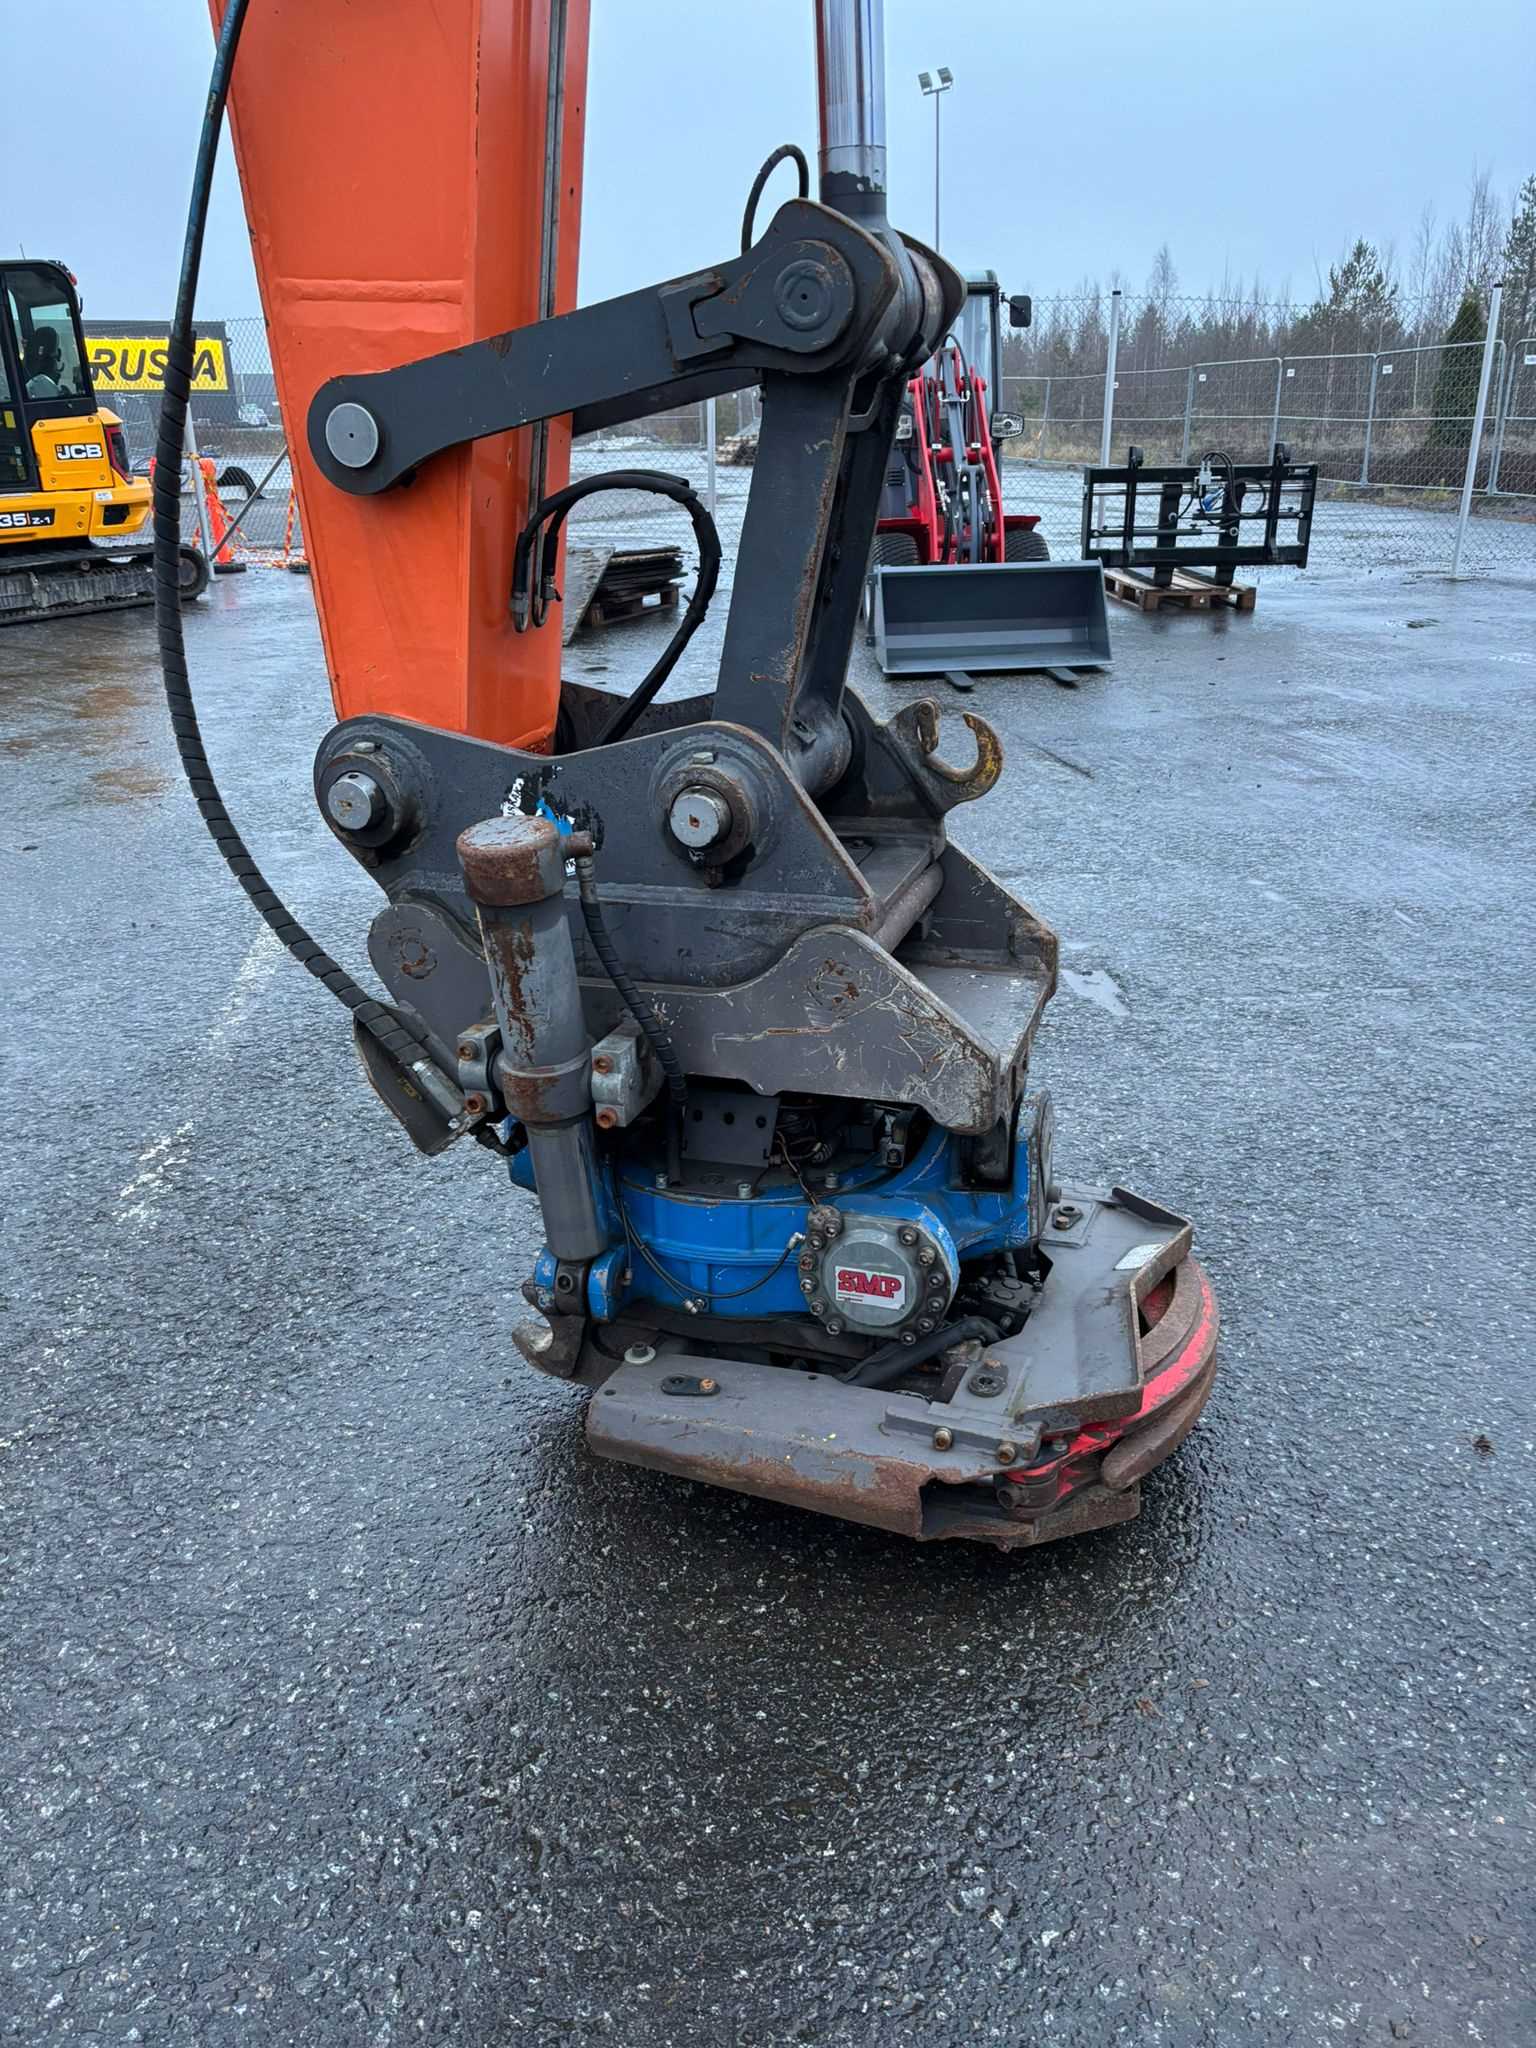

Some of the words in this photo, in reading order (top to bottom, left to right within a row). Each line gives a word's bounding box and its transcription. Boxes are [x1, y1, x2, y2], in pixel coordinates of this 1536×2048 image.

[88, 348, 217, 381] RUSA
[56, 444, 103, 460] JCB
[837, 1269, 902, 1299] SMP
